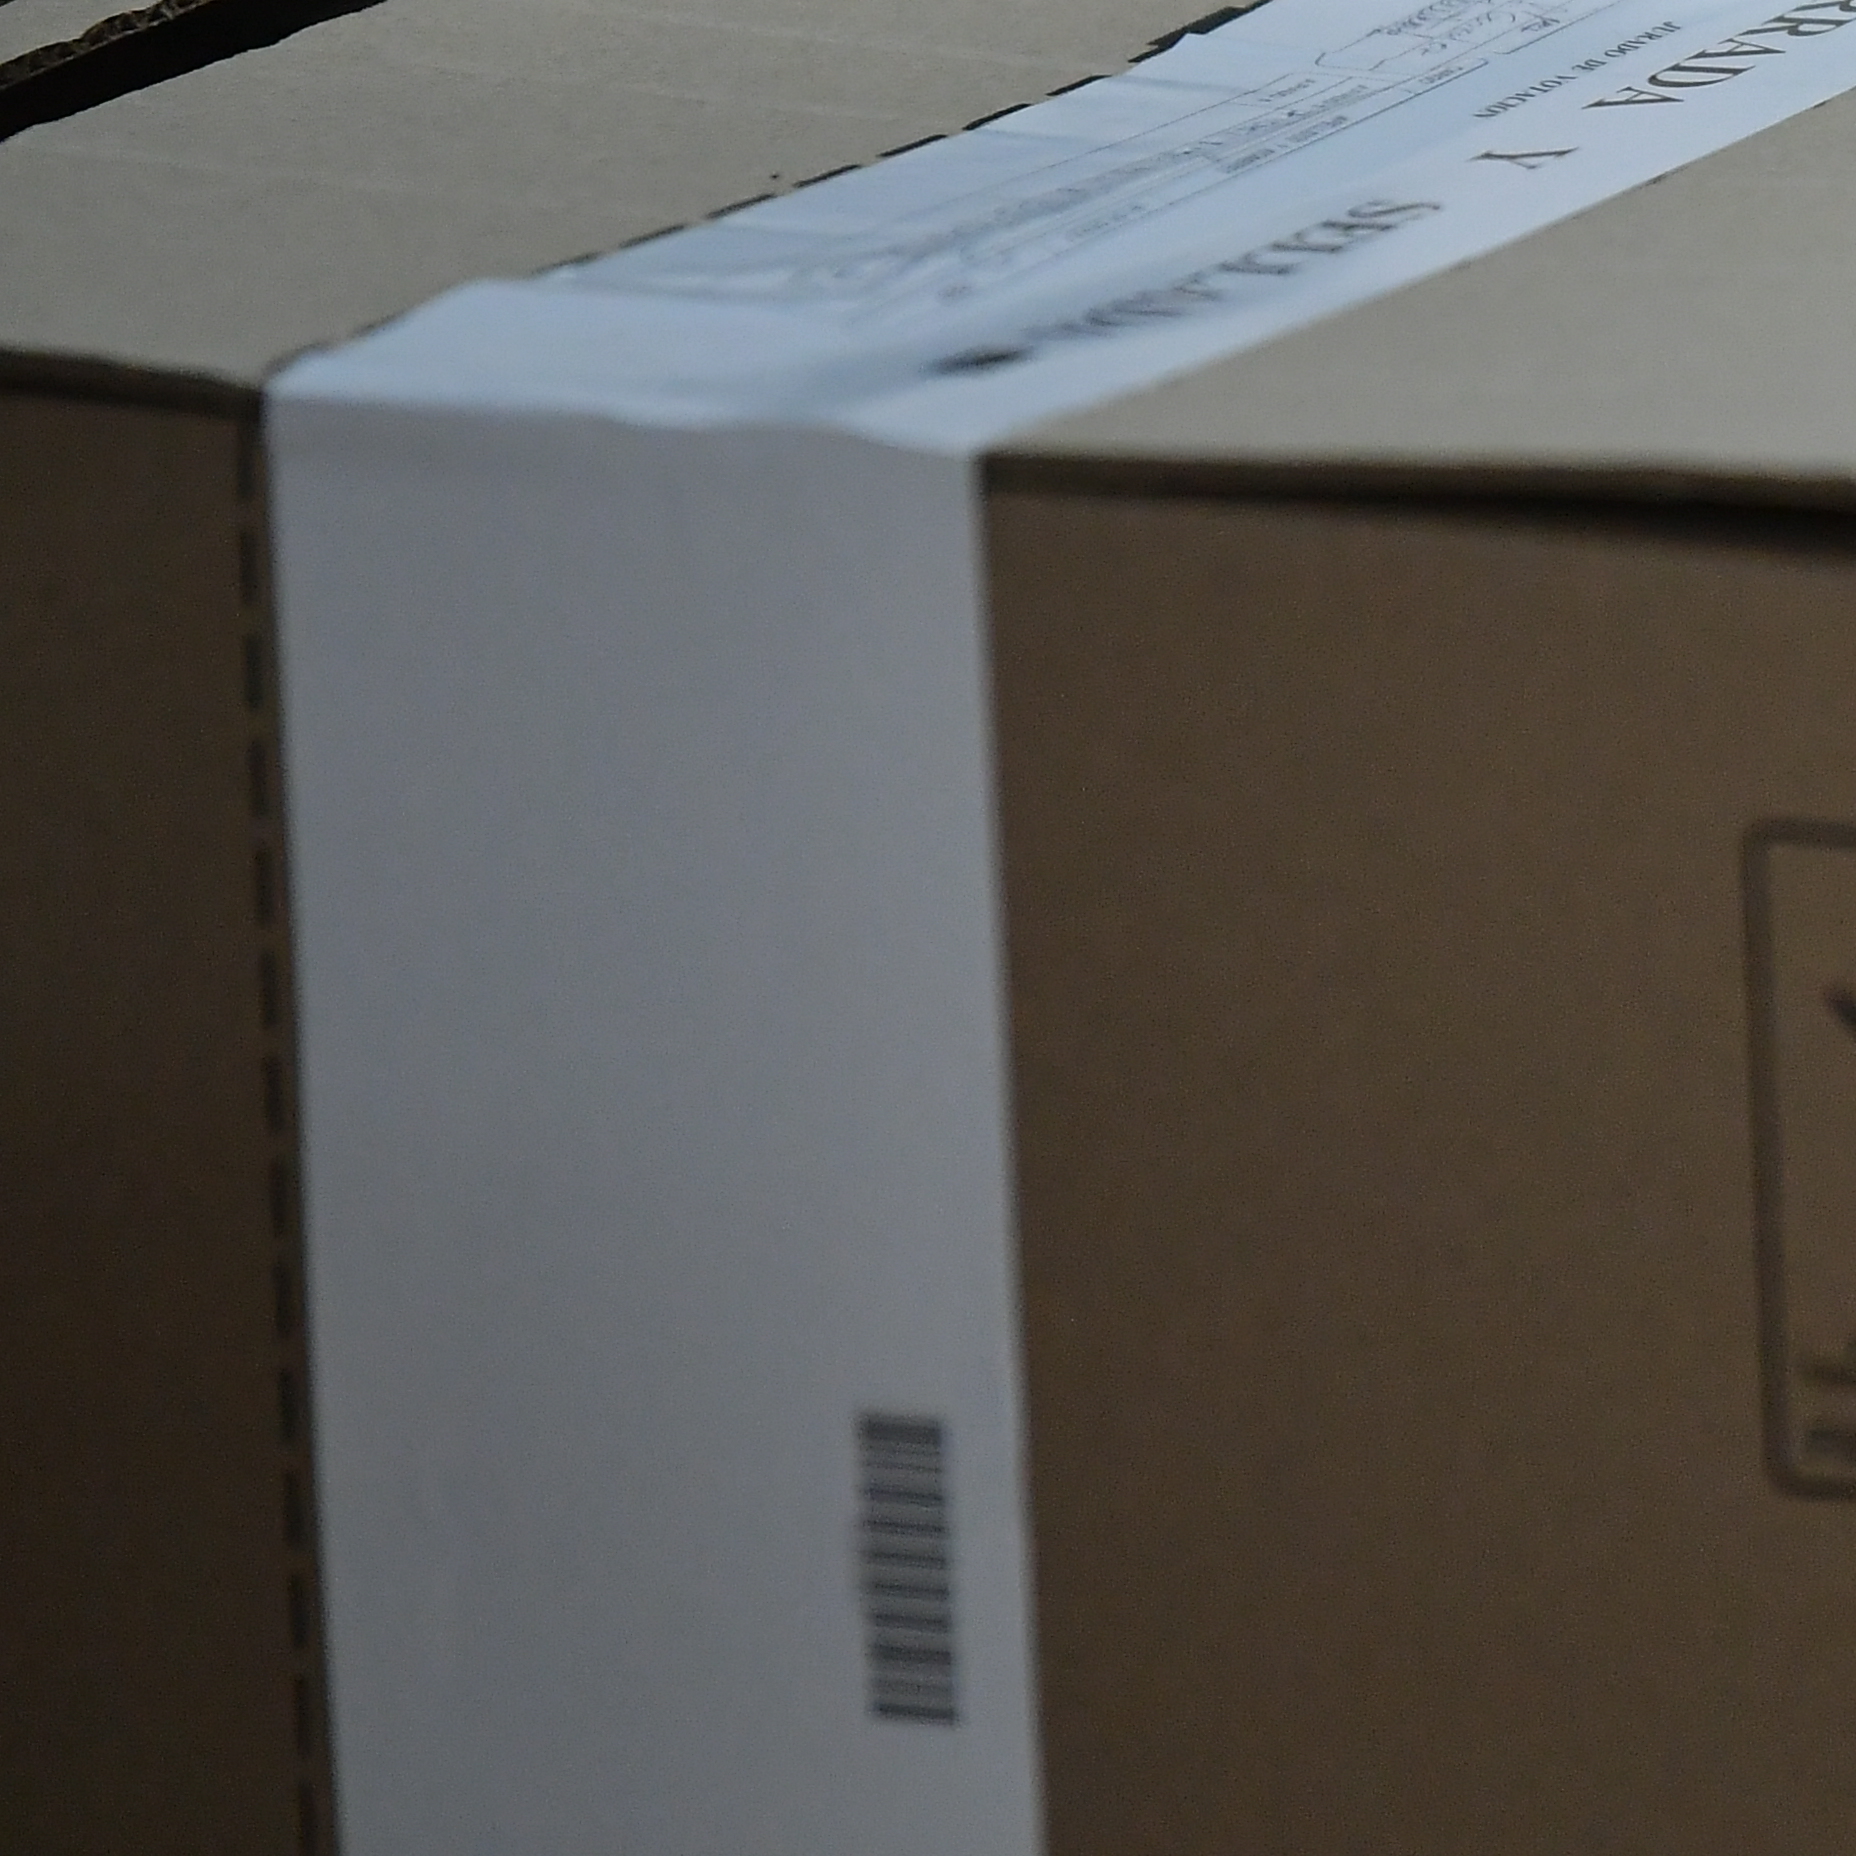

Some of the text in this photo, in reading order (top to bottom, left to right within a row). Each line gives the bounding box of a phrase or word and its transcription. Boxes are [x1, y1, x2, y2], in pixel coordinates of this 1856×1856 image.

[1603, 20, 1682, 59] JURADO
[1571, 58, 1608, 72] DE
[1466, 146, 1580, 170] Y
